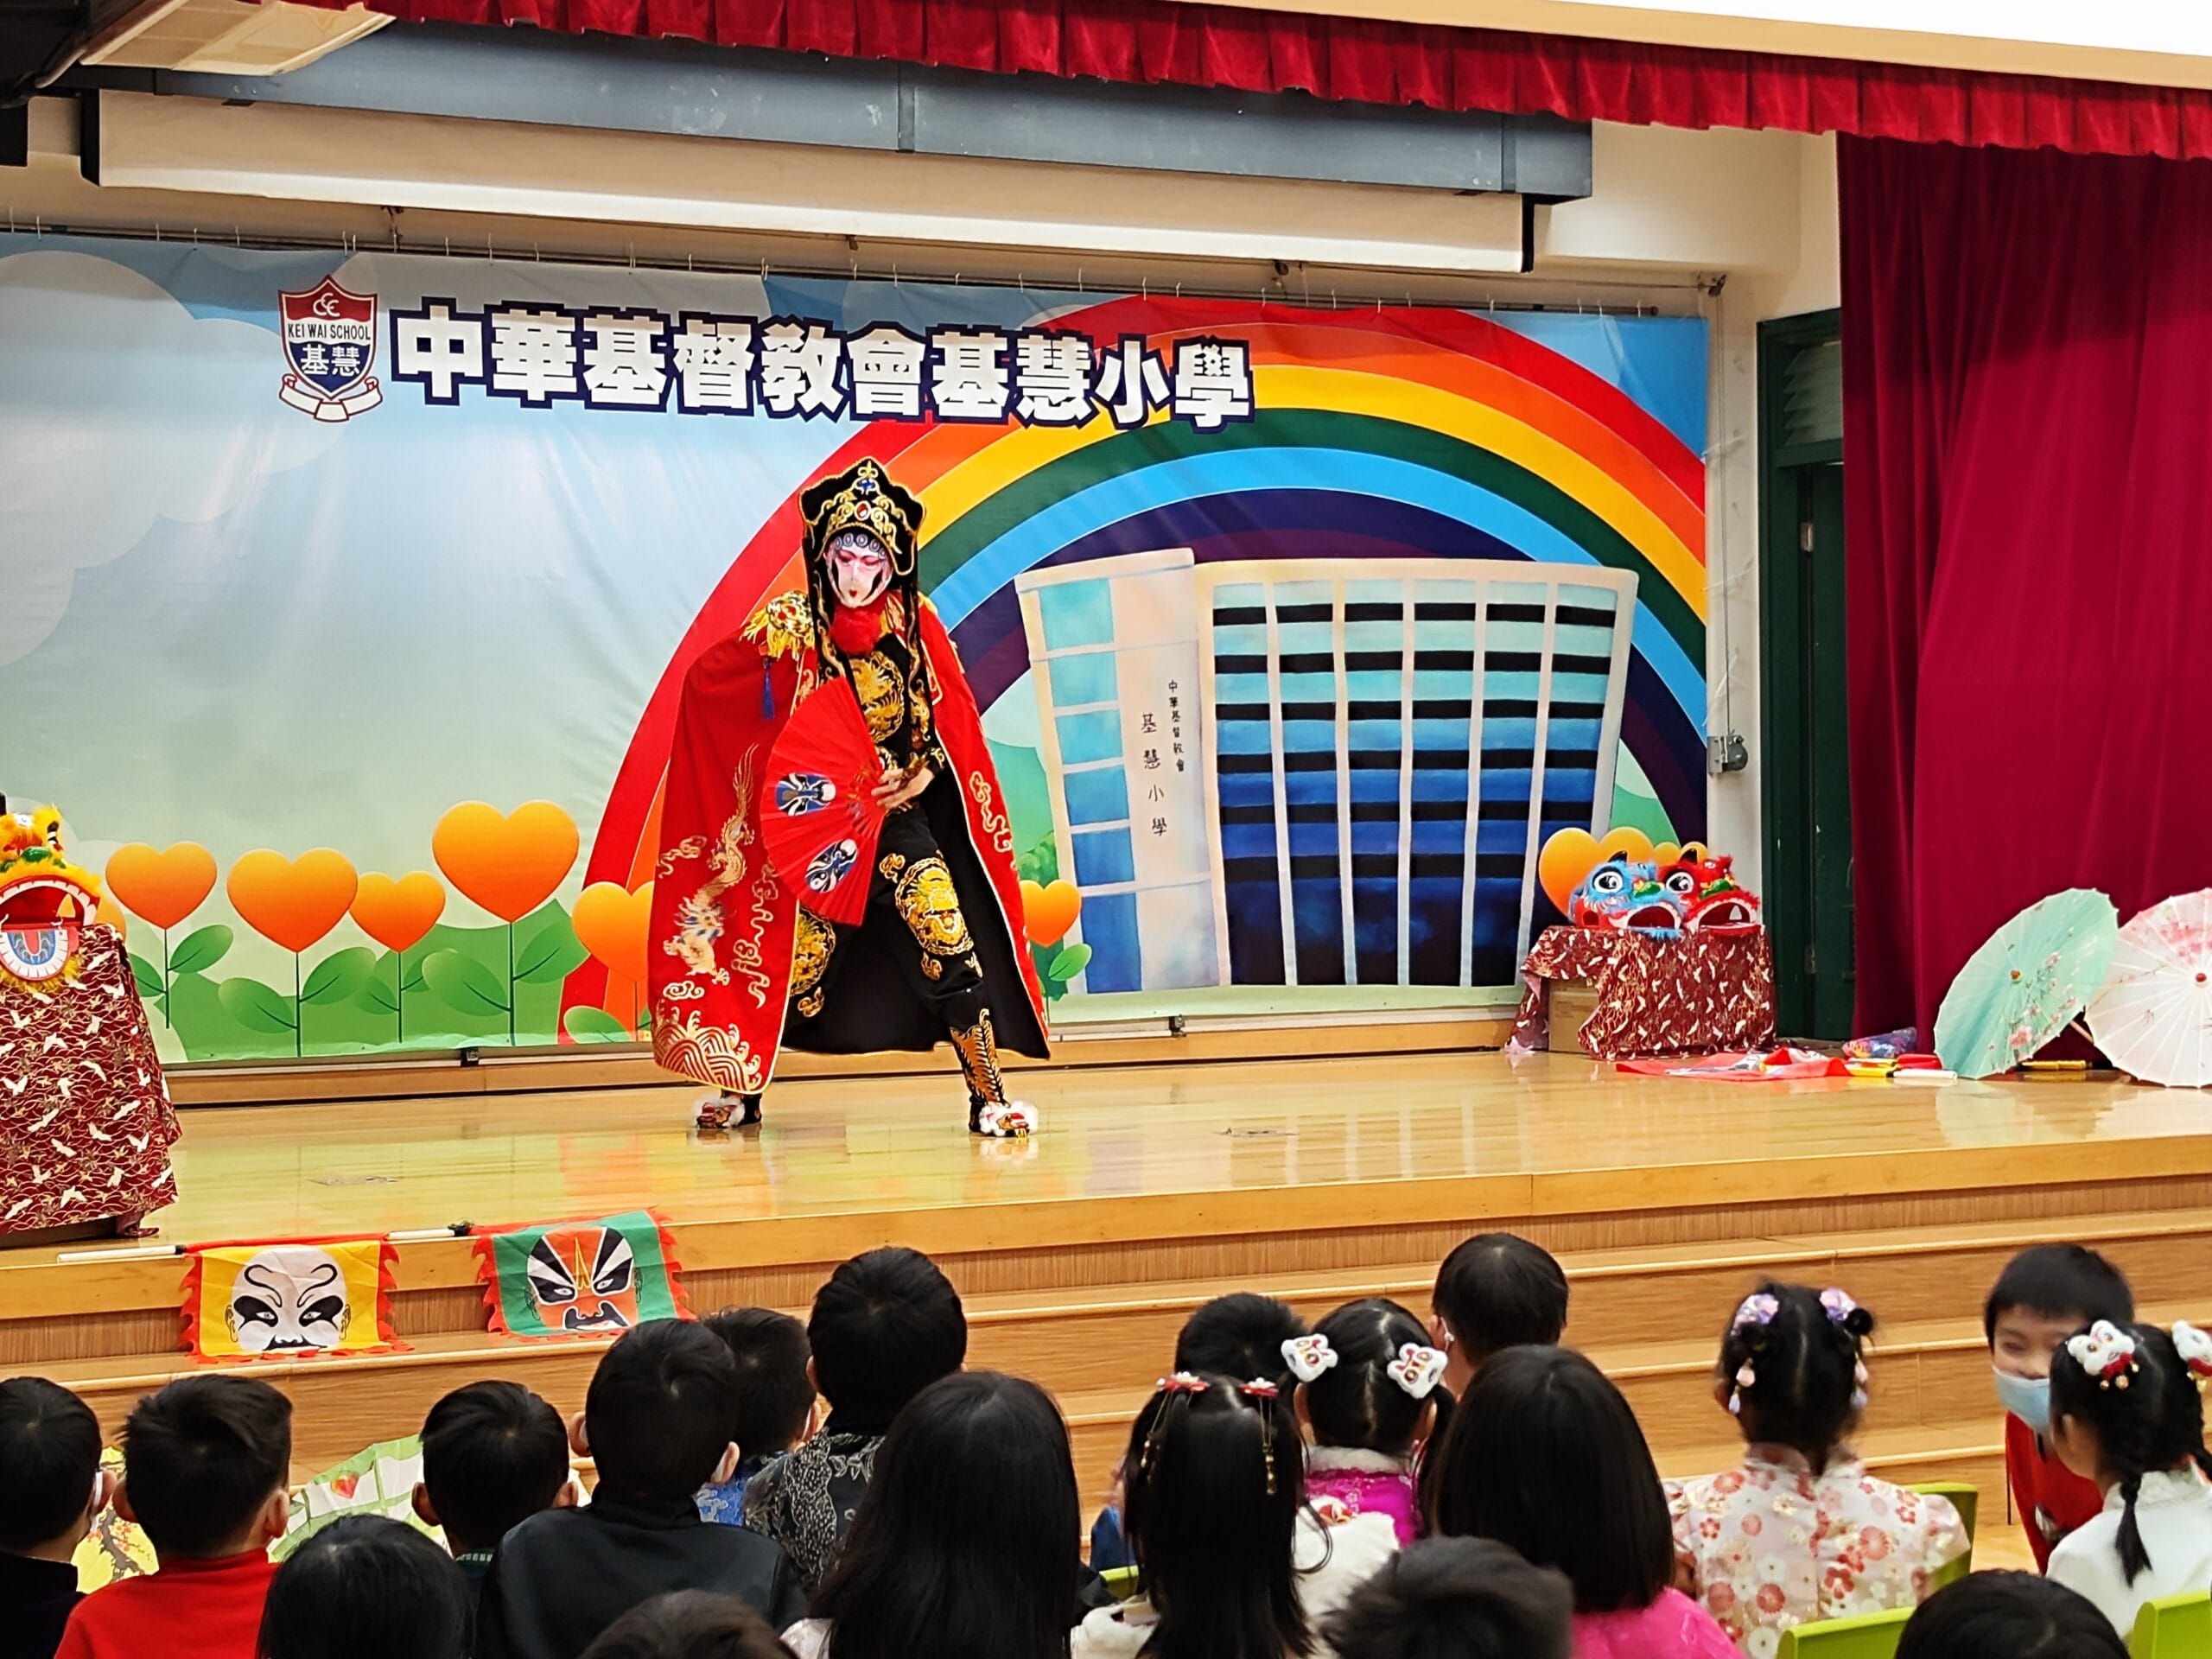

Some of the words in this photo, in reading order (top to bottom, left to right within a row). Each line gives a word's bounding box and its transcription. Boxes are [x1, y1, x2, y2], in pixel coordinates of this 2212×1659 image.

[288, 323, 305, 338] KEI
[308, 324, 327, 339] WAI
[330, 324, 371, 340] SCHOOL
[301, 343, 360, 376] 基慧
[391, 299, 1253, 432] 中華基督教會基慧小學
[1141, 712, 1167, 836] 基慧小學
